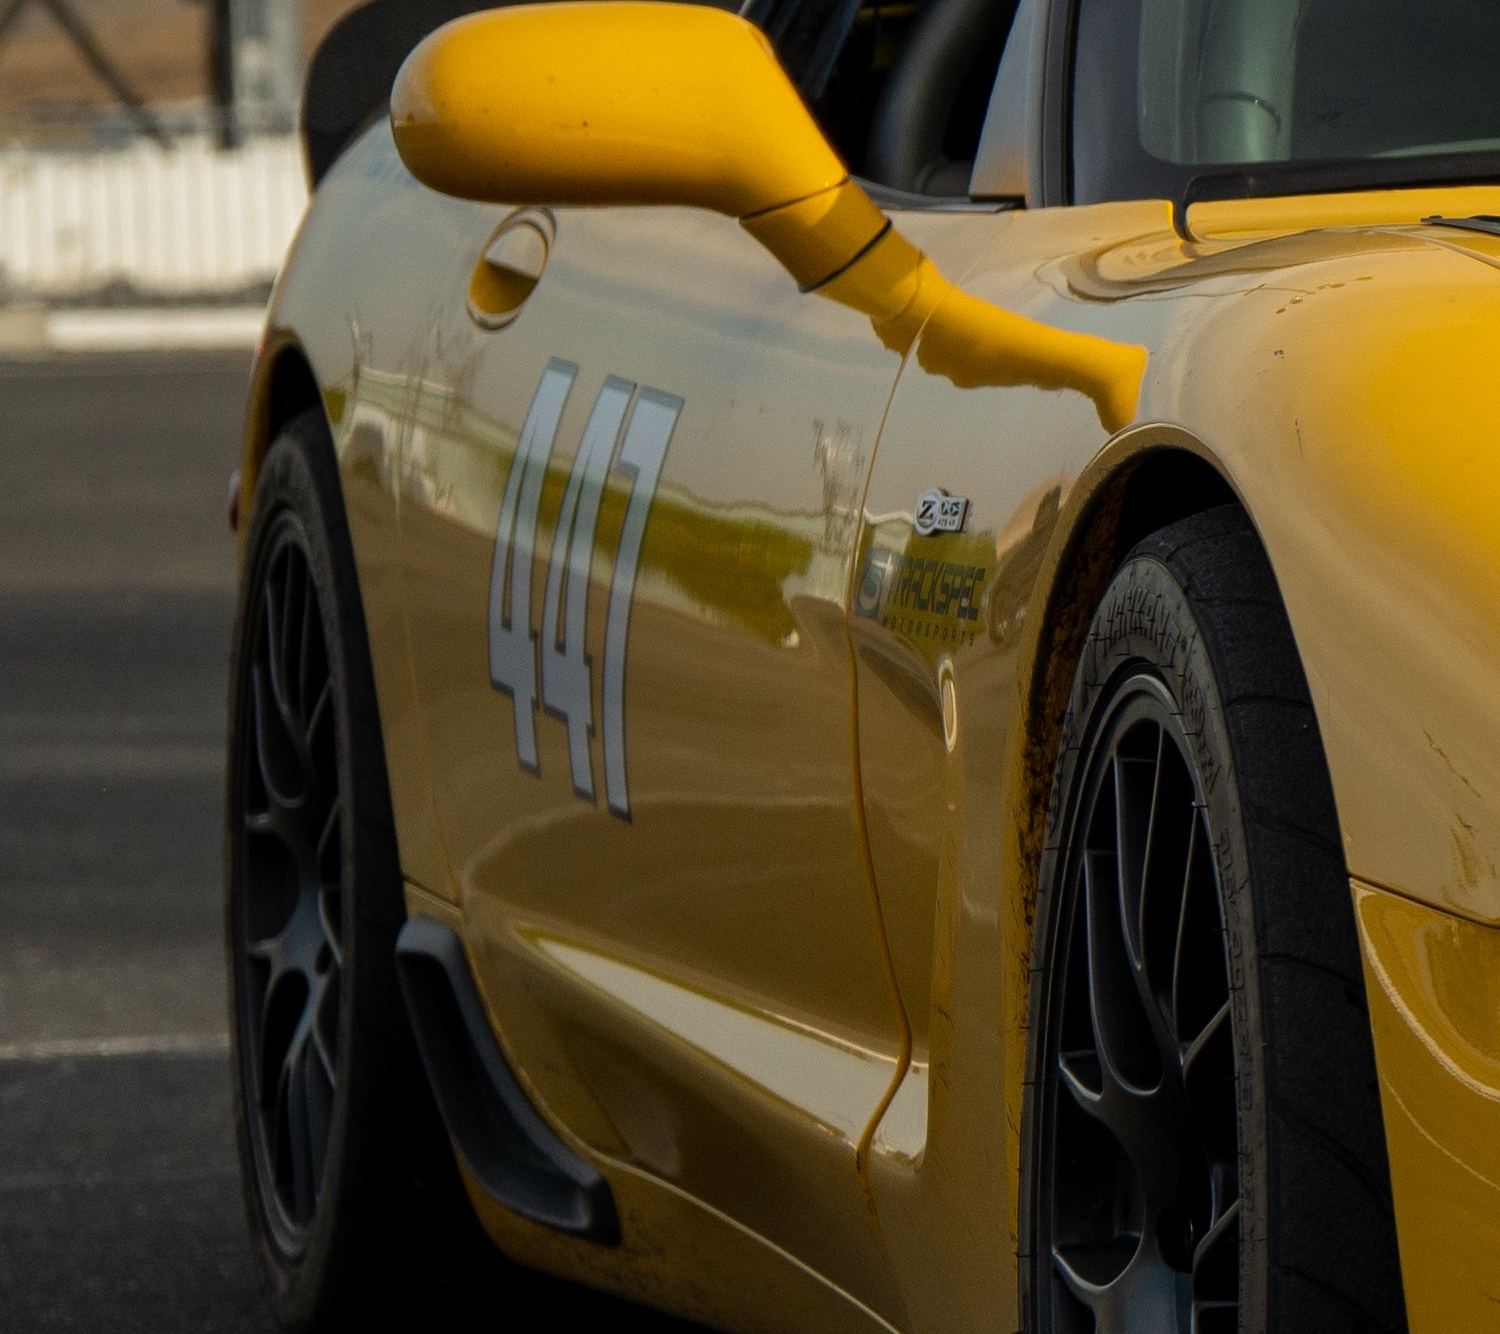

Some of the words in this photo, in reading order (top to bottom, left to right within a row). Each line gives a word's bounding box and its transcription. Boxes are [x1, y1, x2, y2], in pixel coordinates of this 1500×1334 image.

[488, 356, 687, 825] 447
[885, 550, 986, 621] TRACKSPEC
[881, 613, 976, 647] MOTORSPORTS
